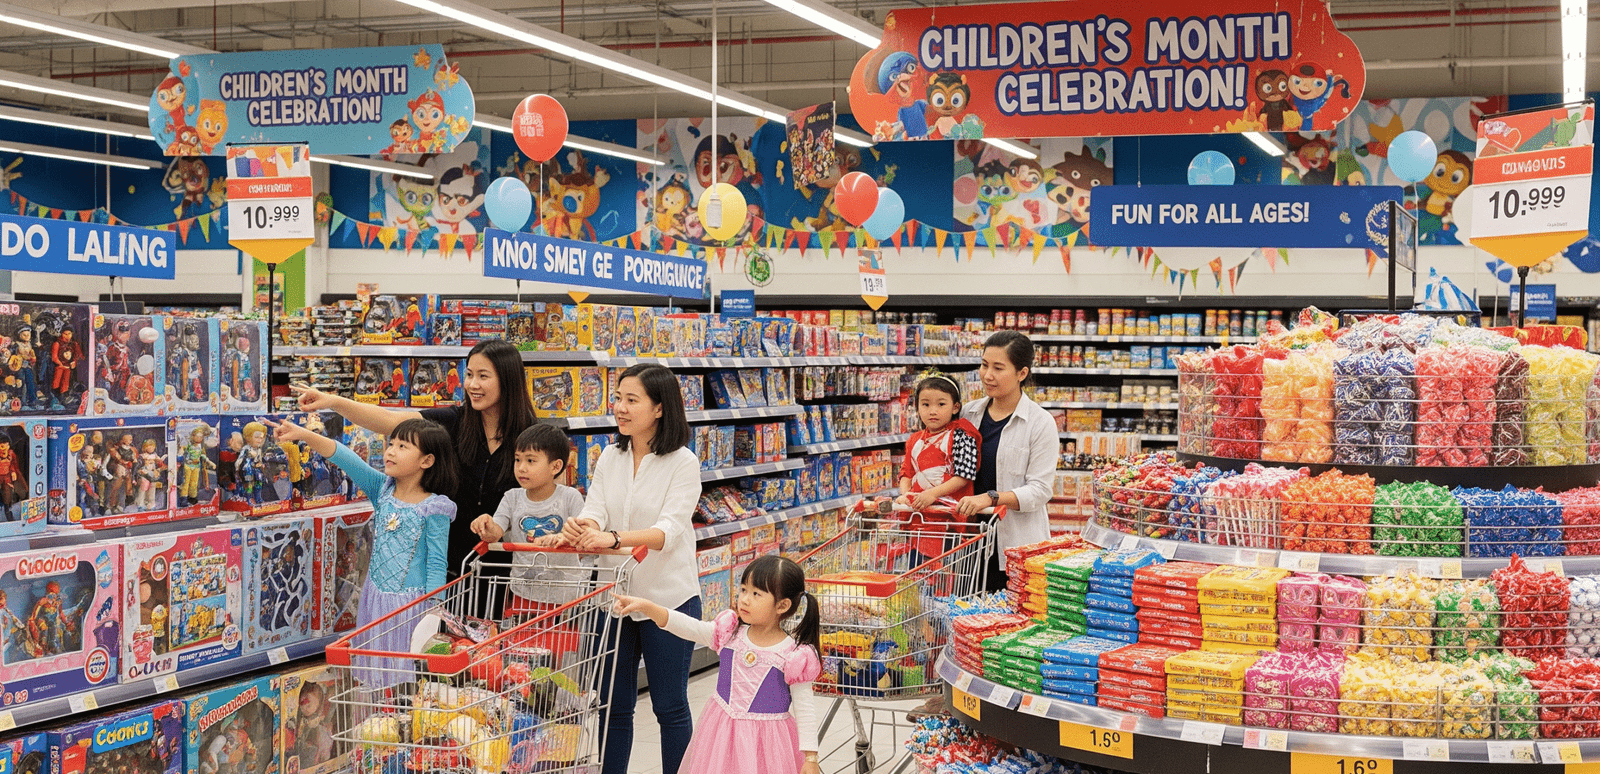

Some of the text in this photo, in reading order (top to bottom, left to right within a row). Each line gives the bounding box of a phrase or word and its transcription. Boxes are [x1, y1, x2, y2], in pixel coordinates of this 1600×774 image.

[920, 14, 1290, 69] CHILDREN'S MONTH
[220, 66, 408, 99] CHILDREN'S MONTH
[998, 66, 1247, 114] CELEBRATION!
[248, 96, 382, 126] CELEBRATION!
[1112, 202, 1310, 225] FUN FOR ALL AGES!
[1, 221, 50, 259] DO
[593, 251, 613, 280] GE
